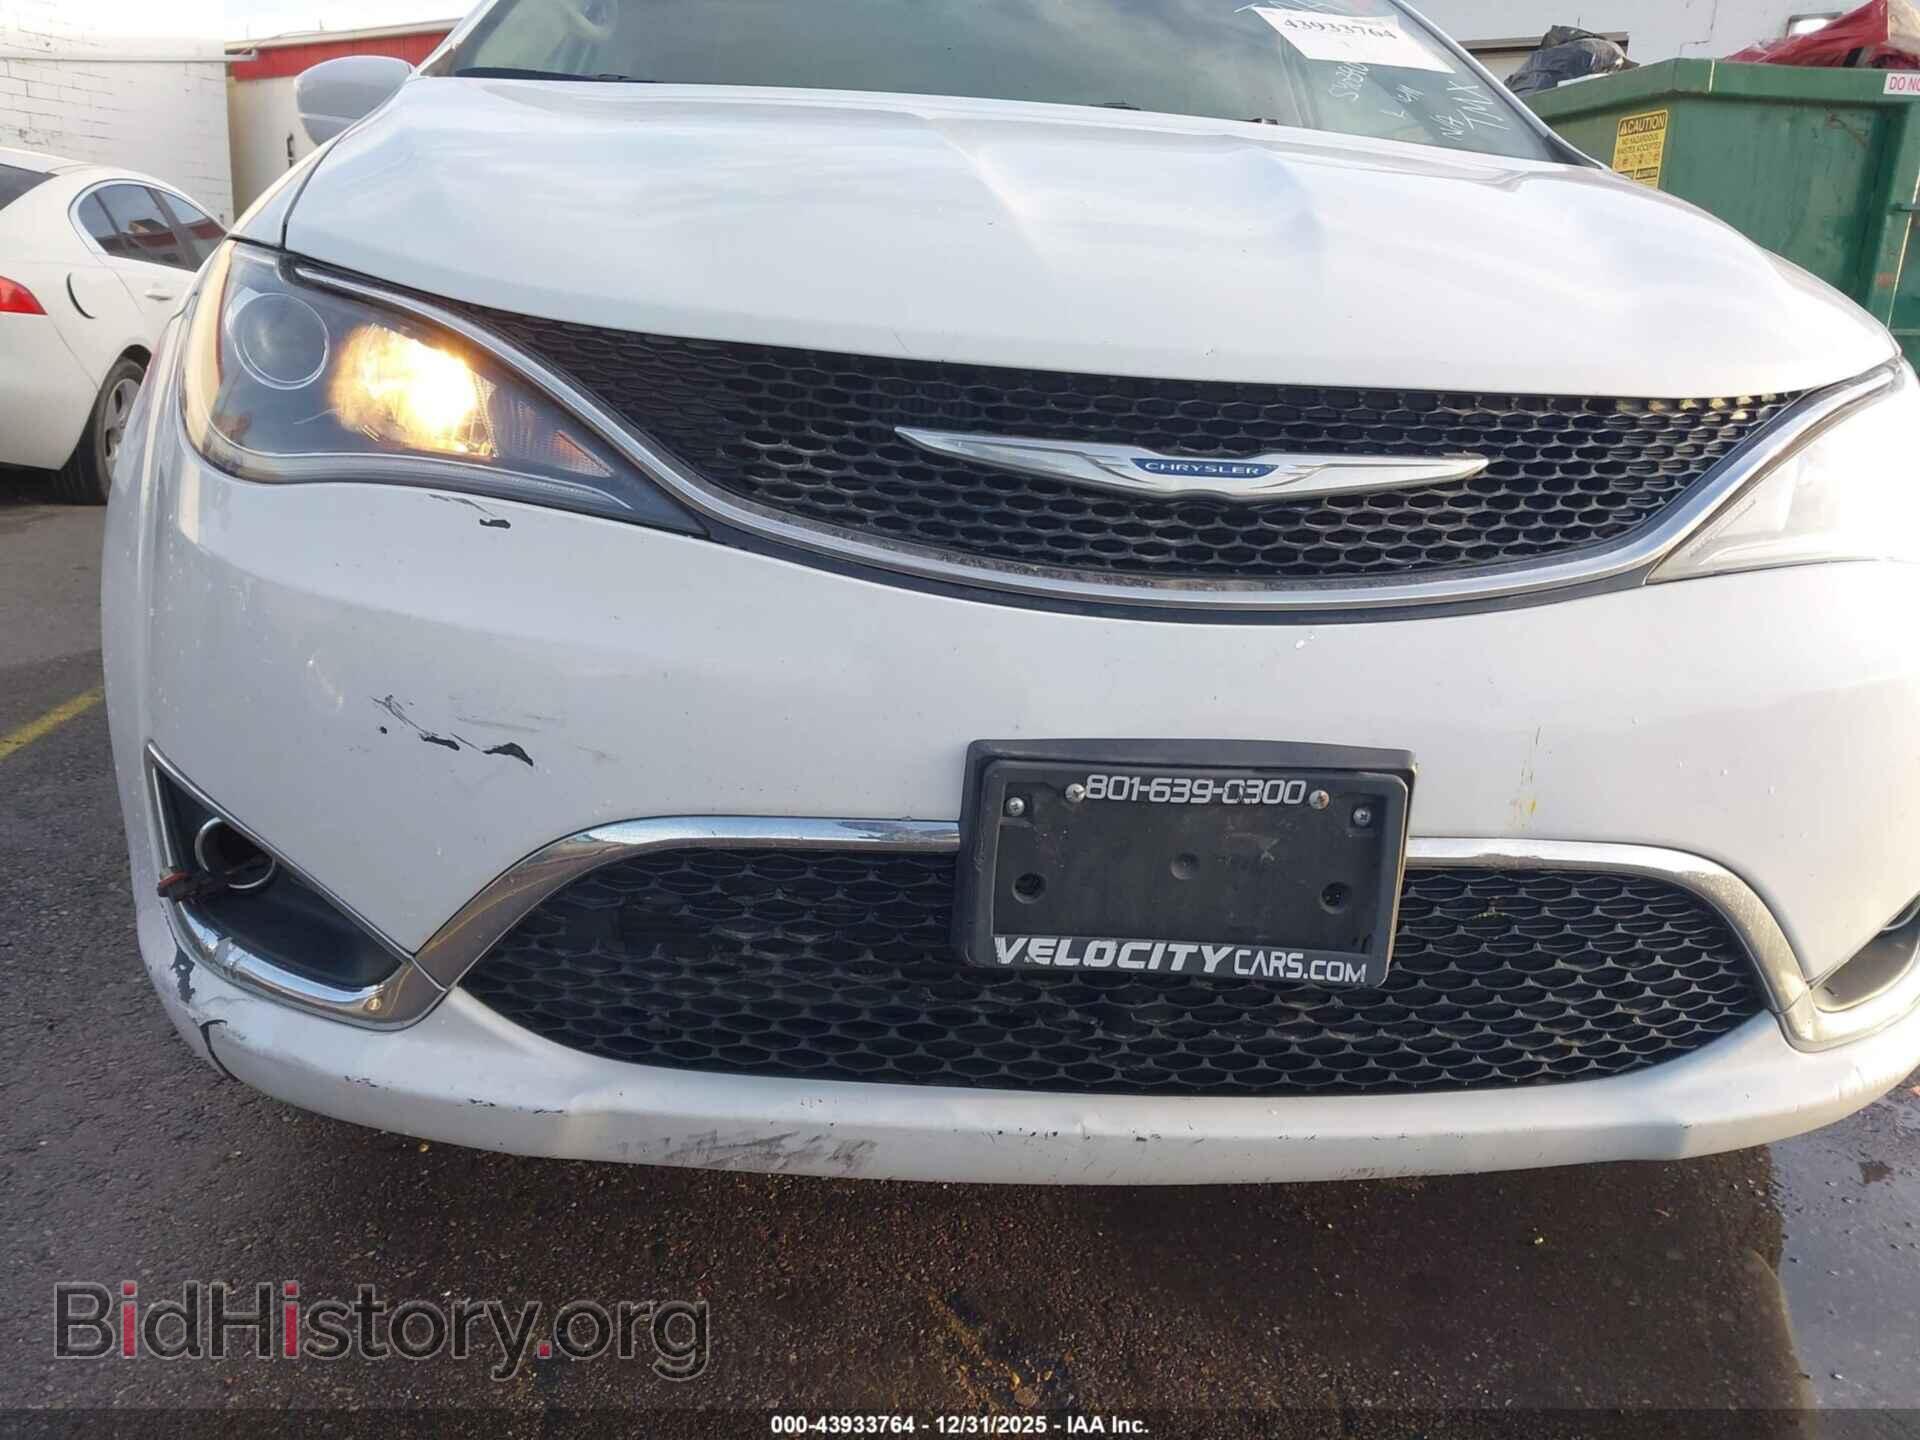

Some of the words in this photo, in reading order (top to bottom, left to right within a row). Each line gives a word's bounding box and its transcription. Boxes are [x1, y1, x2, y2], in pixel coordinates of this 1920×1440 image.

[1284, 18, 1398, 40] 43933764
[1890, 76, 1905, 90] DO
[1627, 114, 1665, 134] CAUTION
[1144, 462, 1260, 475] CHRYSLER
[1086, 774, 1307, 805] 801-639-0300
